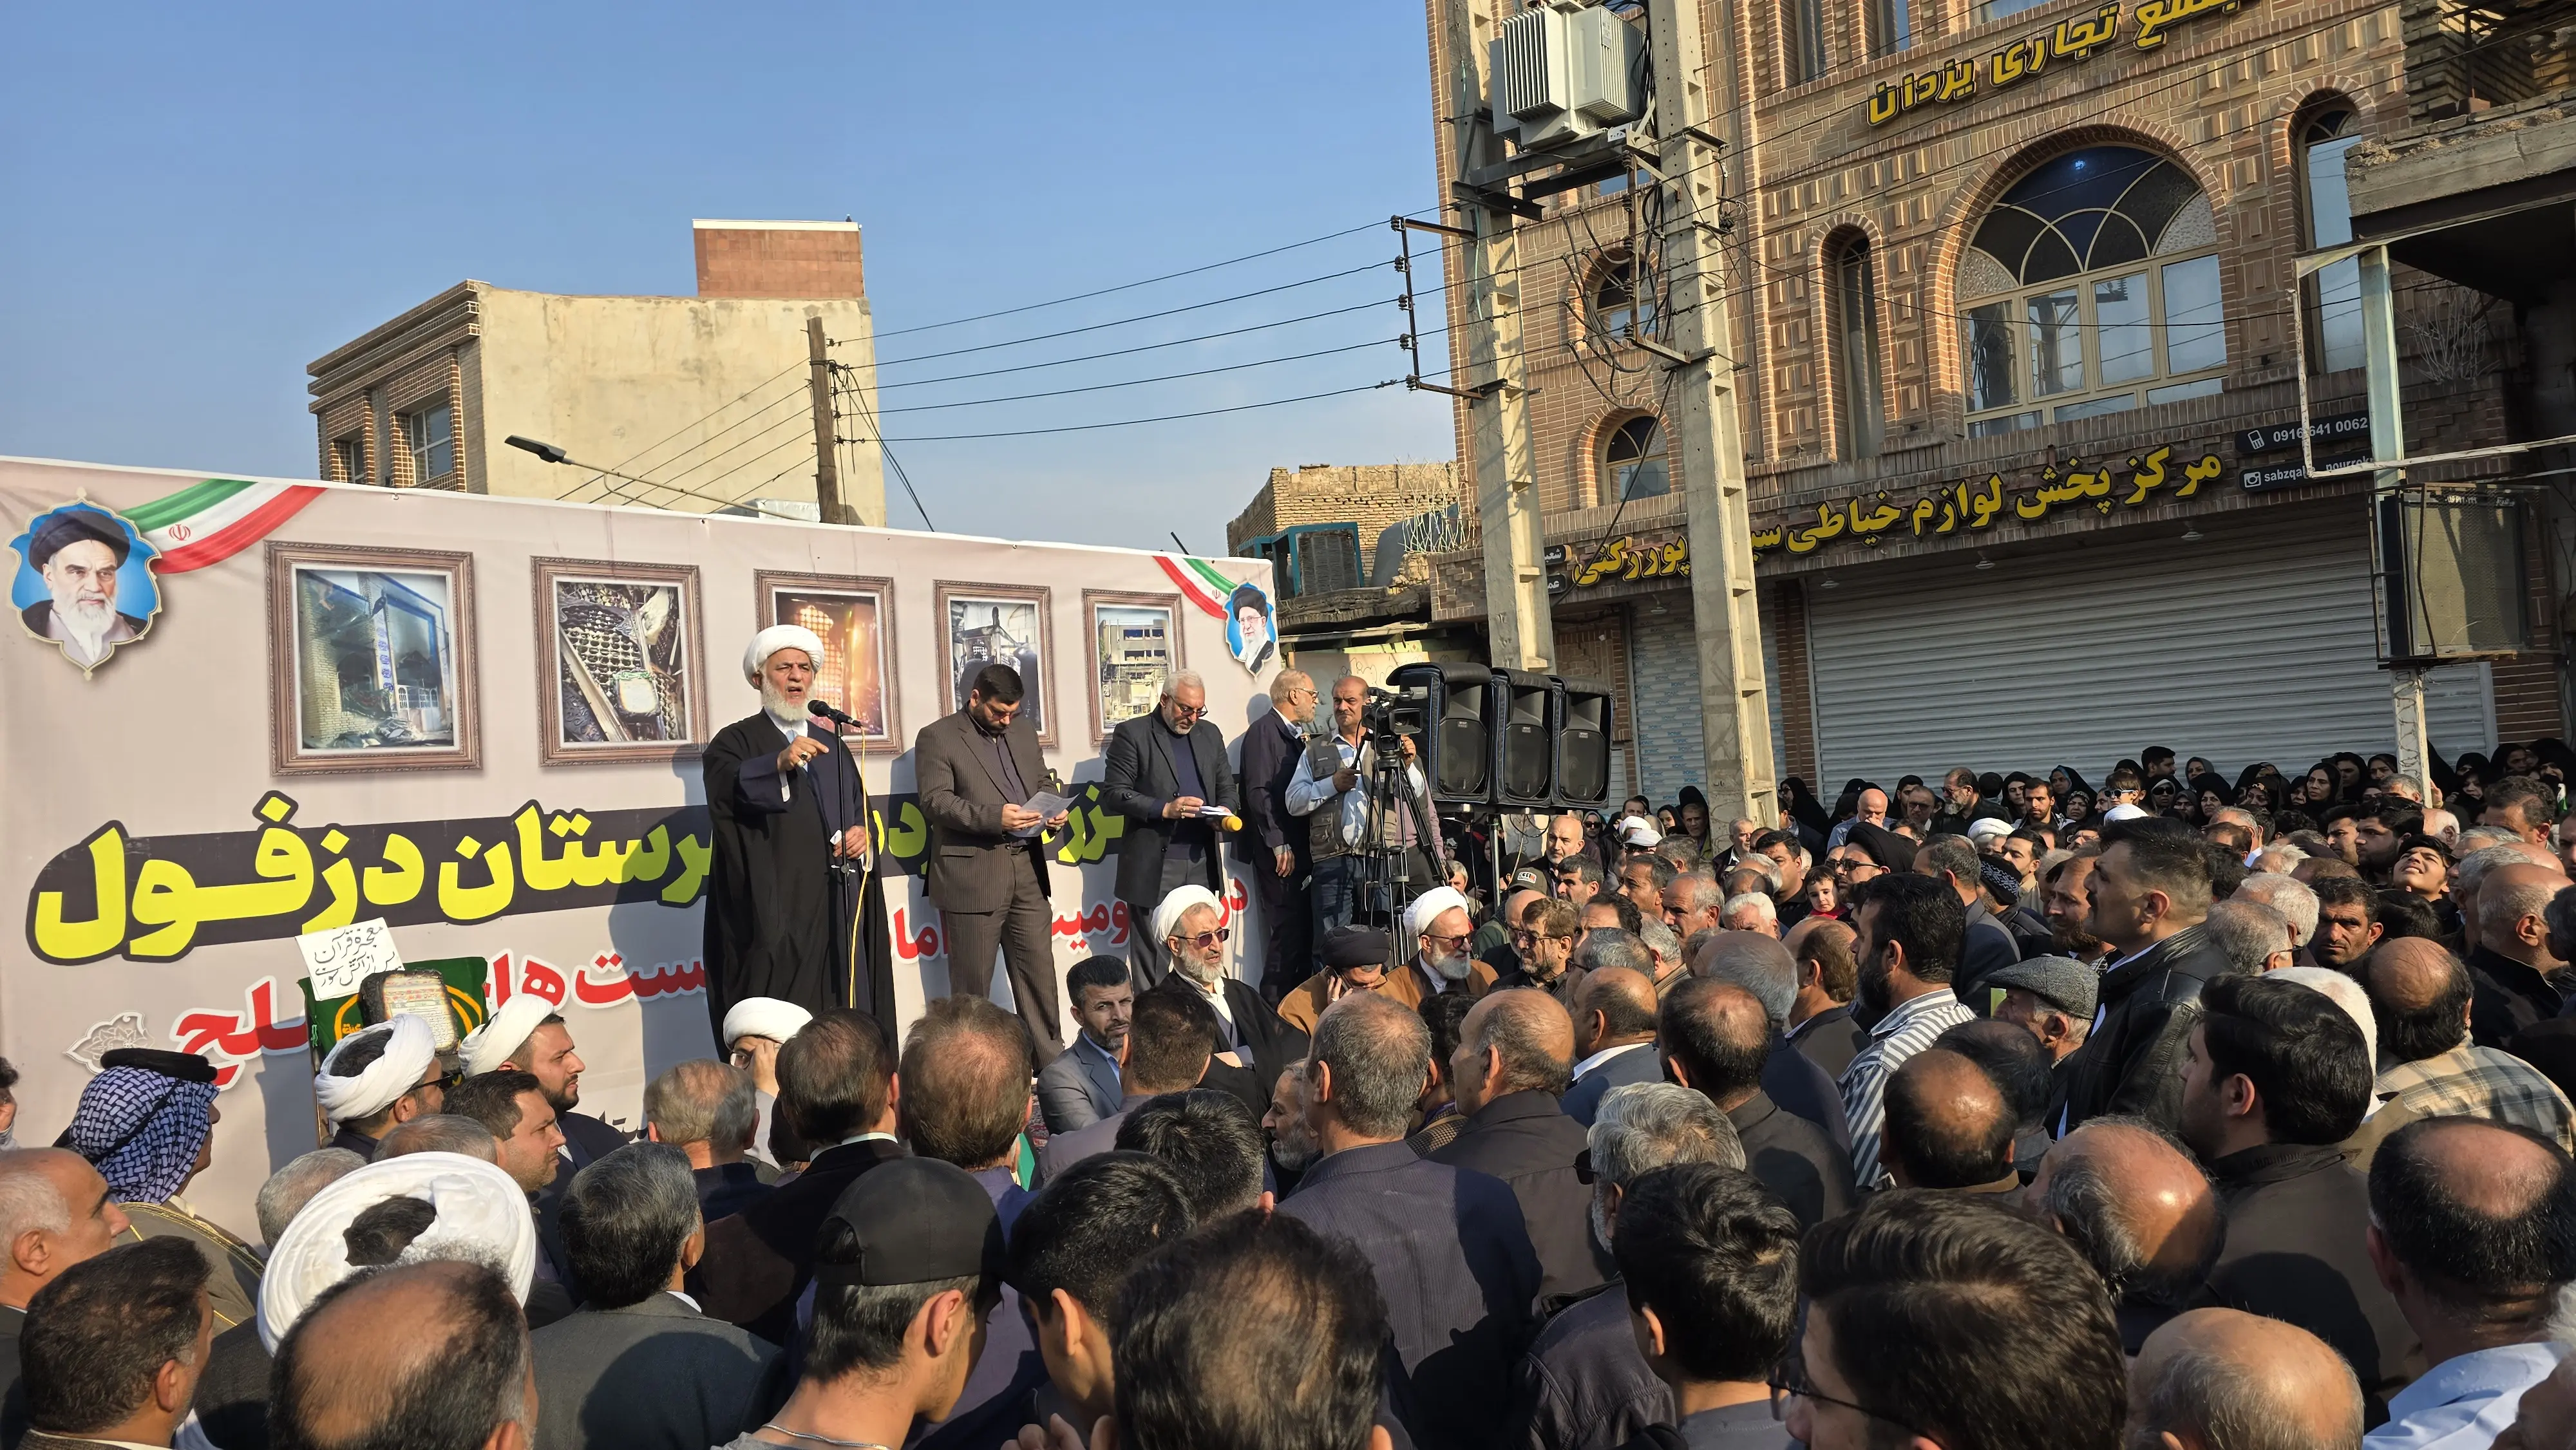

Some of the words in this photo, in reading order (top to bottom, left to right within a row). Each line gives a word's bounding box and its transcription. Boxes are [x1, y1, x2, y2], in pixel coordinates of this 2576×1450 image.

[1991, 3, 2120, 85] تجاری
[1868, 59, 1975, 125] یزدان
[2273, 428, 2304, 442] 0916
[2309, 423, 2331, 437] 641
[2335, 417, 2368, 432] 0062
[1912, 475, 2003, 536] لوازم
[2016, 457, 2111, 518] پخش
[2125, 446, 2222, 504] مرکز
[1787, 491, 1902, 552] خیاطی
[35, 796, 425, 959] دزفول
